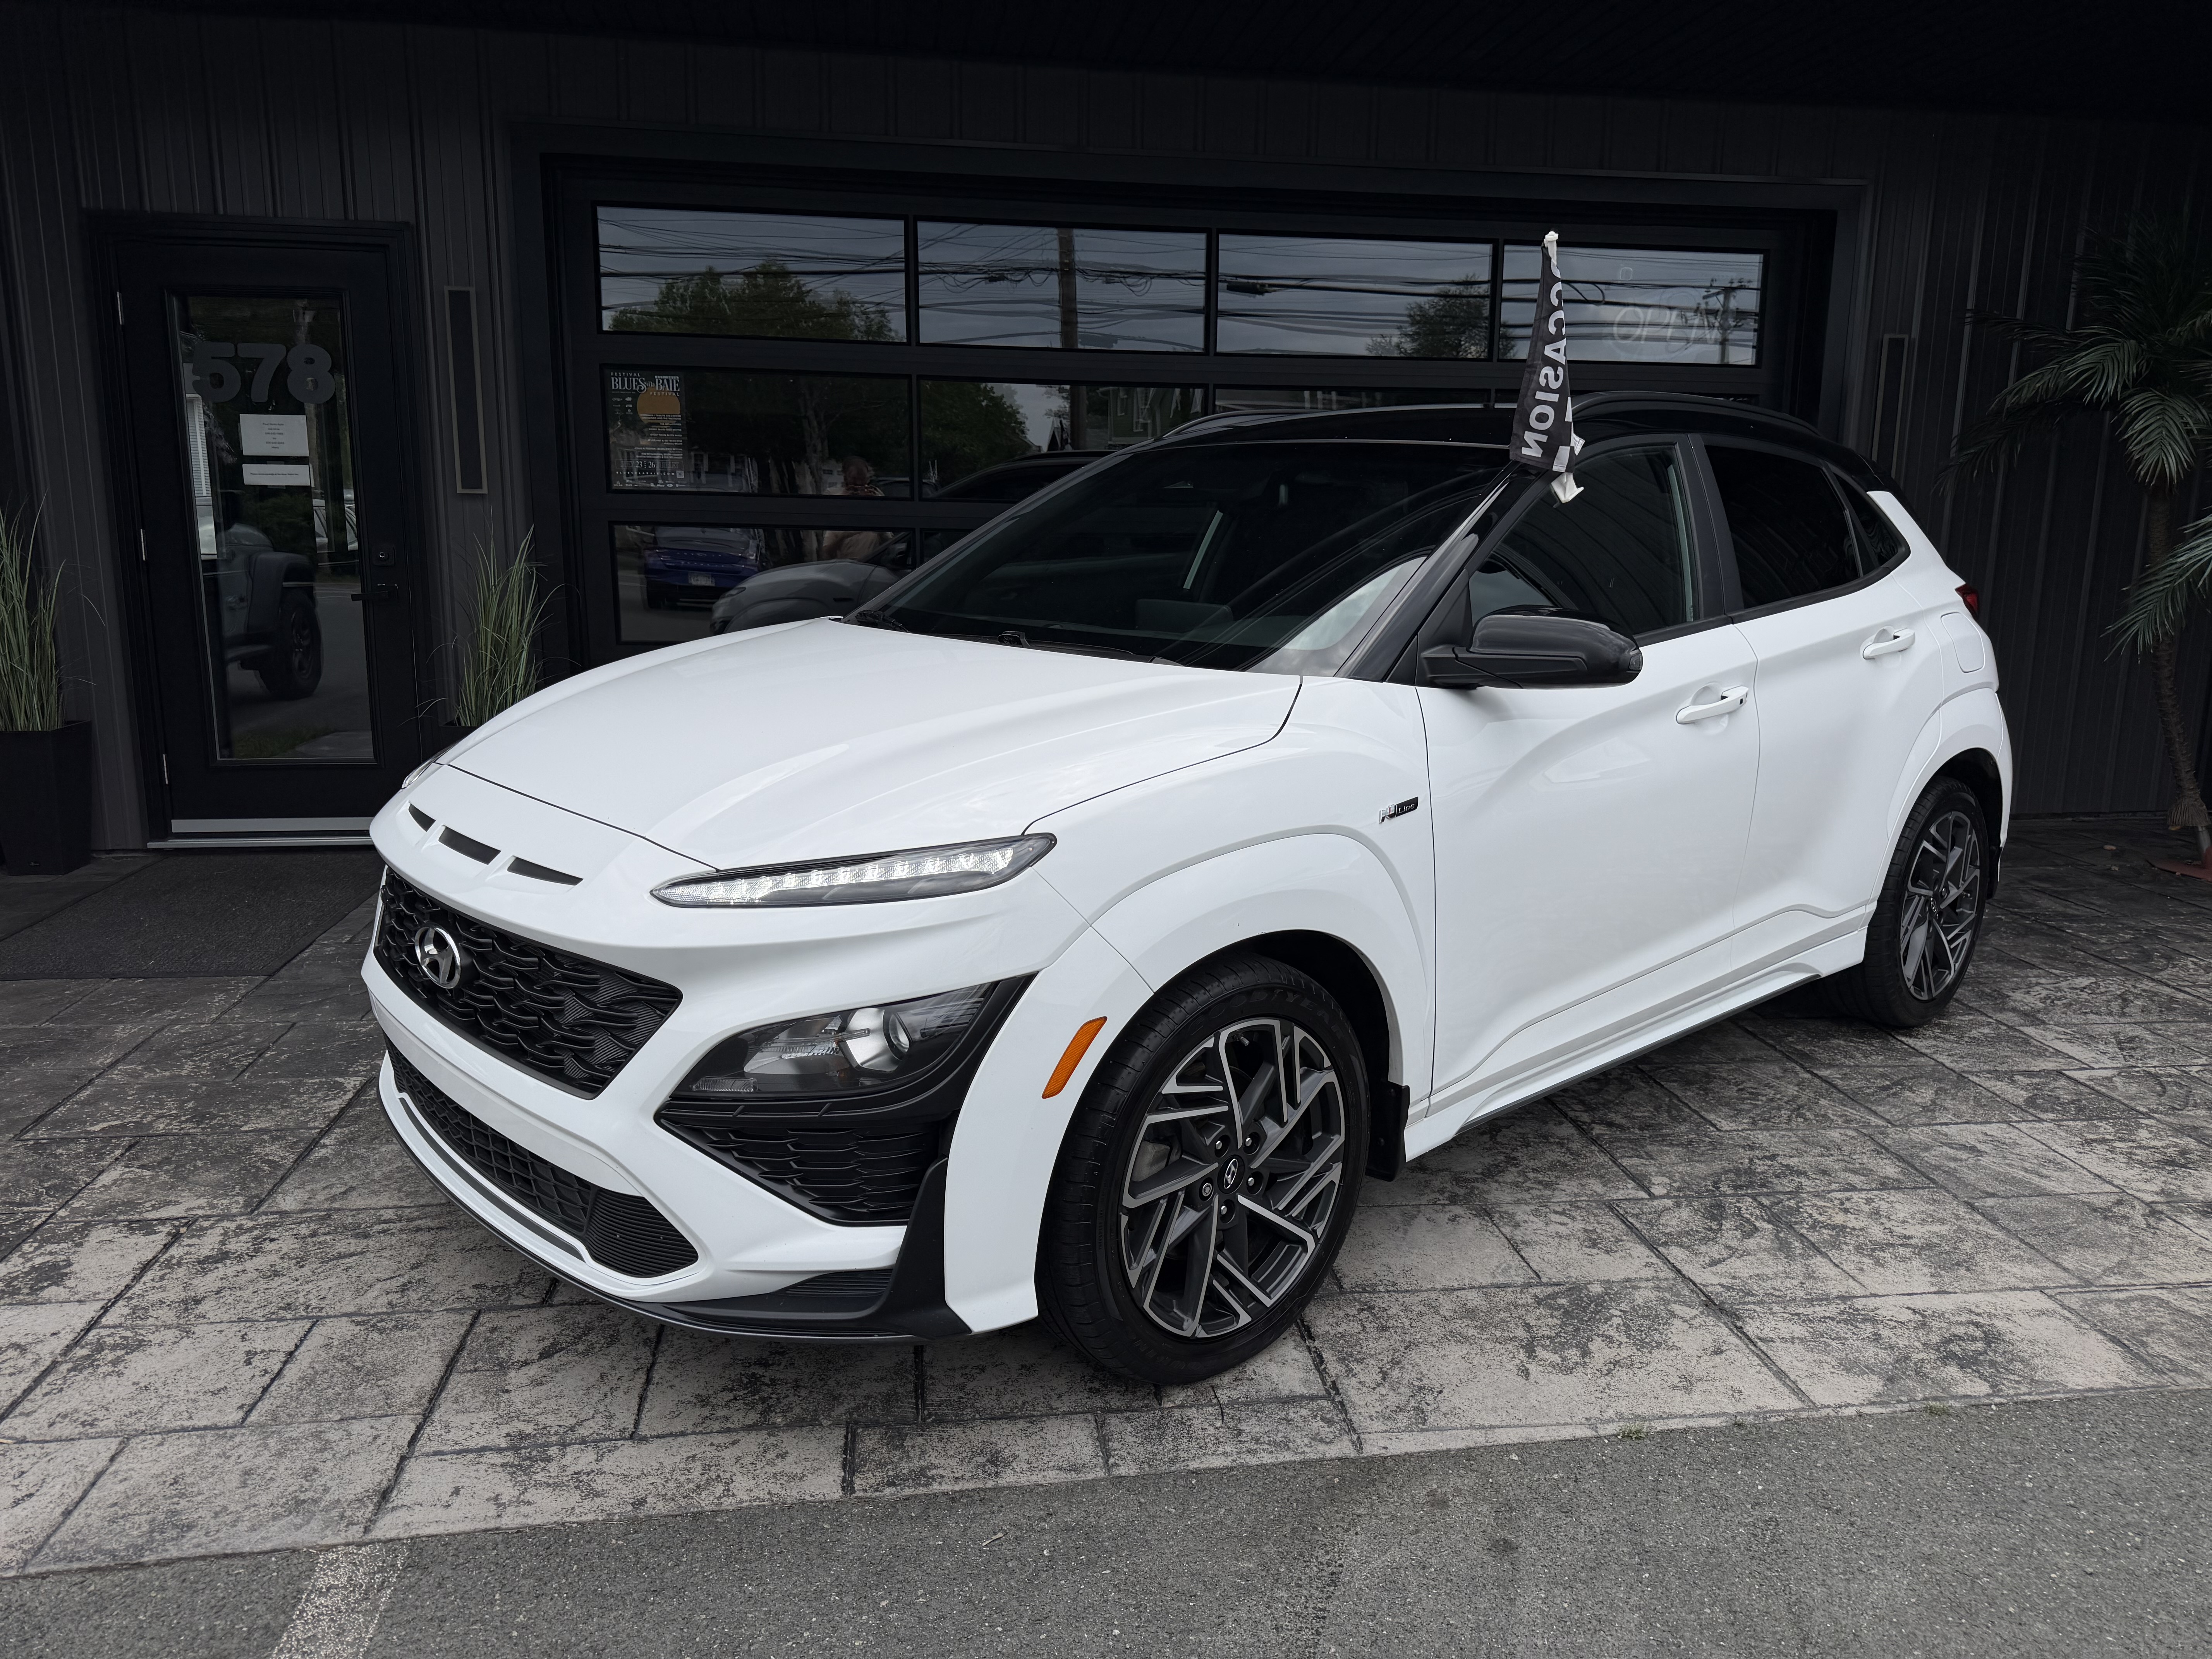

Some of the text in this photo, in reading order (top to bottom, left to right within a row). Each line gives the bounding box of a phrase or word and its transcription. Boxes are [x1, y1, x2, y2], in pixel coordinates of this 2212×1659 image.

[1613, 307, 1722, 344] OPEN
[192, 342, 336, 404] 578
[611, 377, 647, 393] BLUES
[655, 378, 680, 391] BAIE
[1399, 804, 1415, 813] Line
